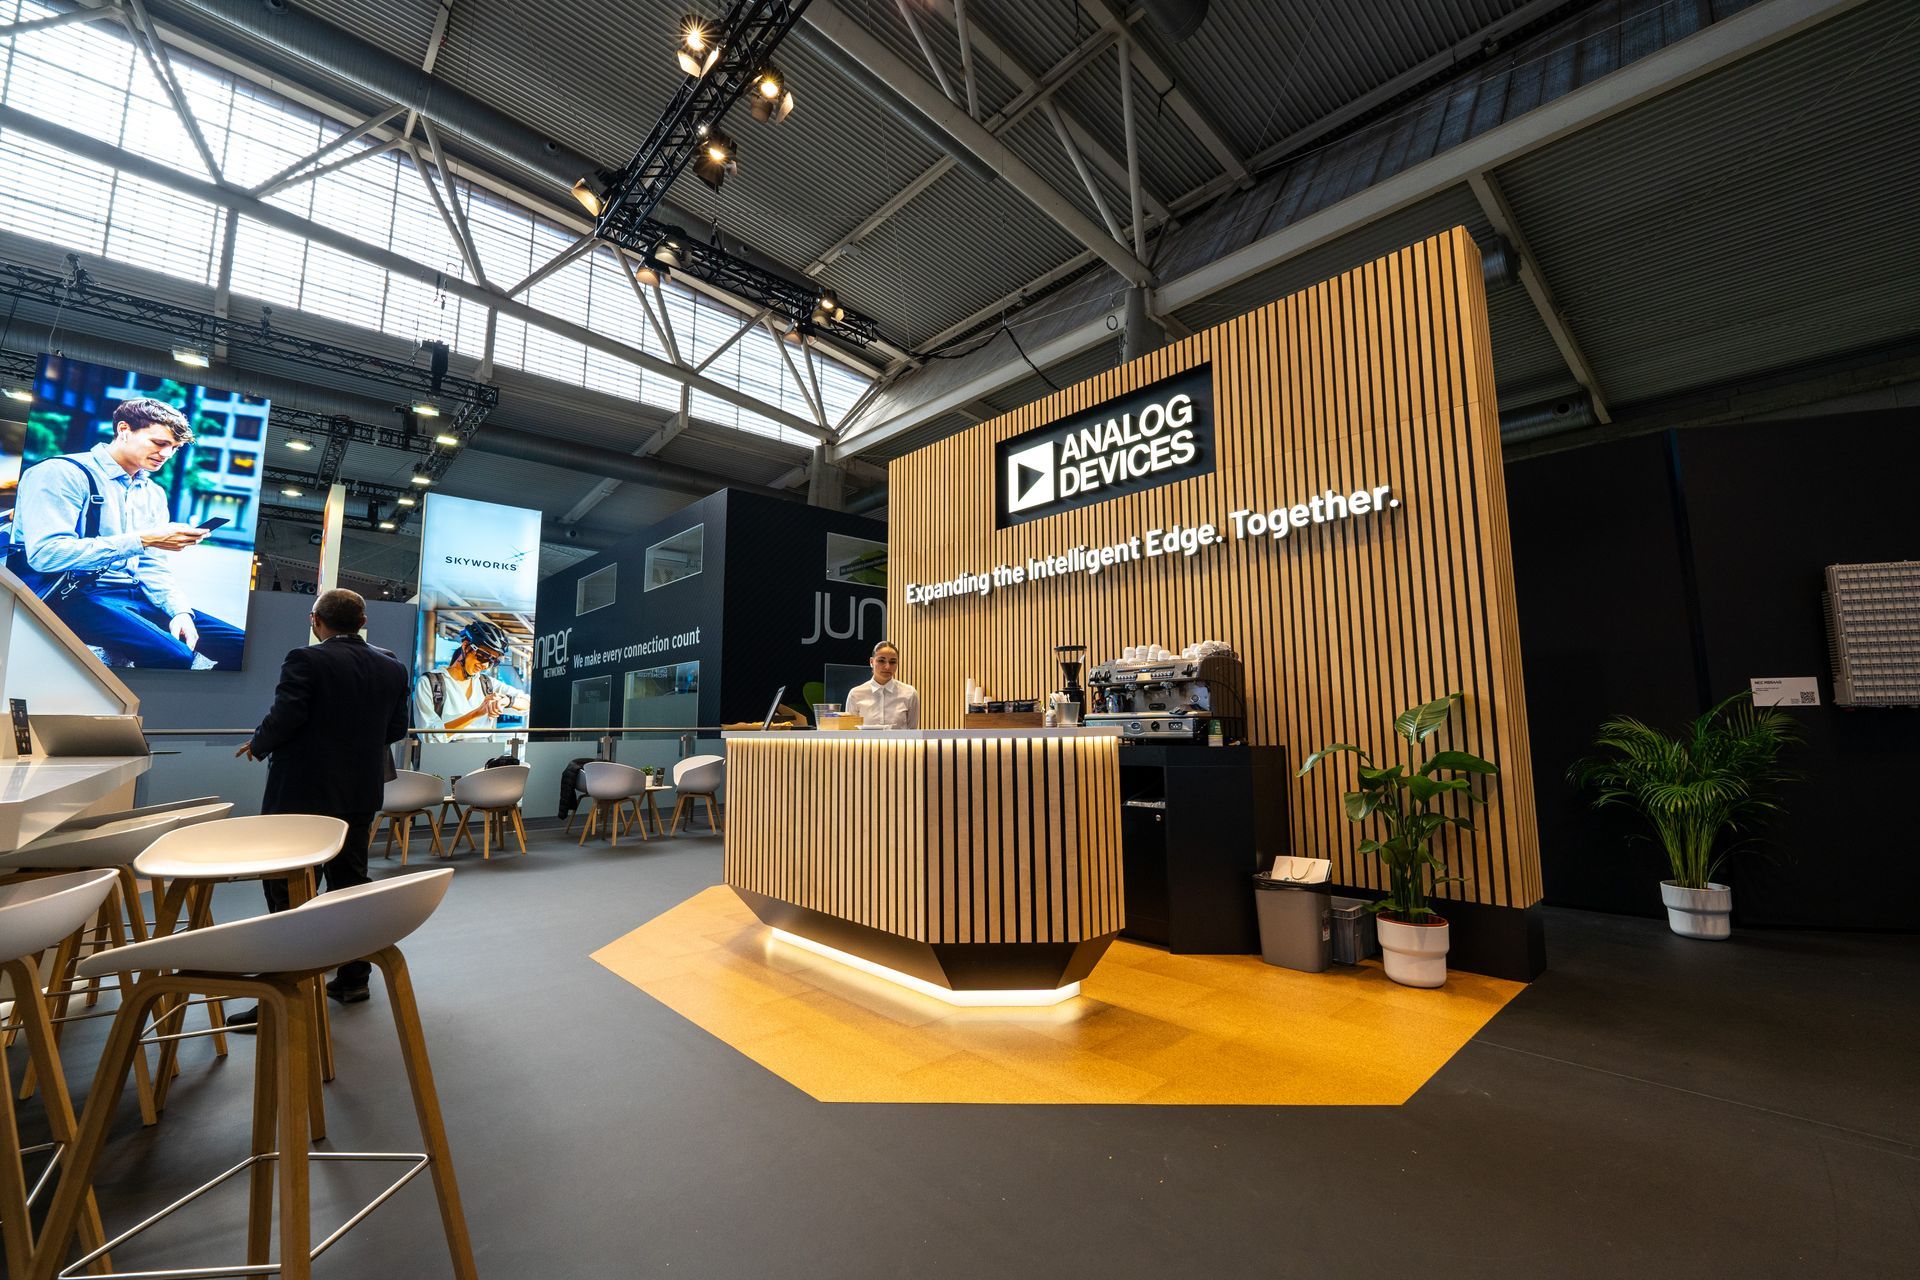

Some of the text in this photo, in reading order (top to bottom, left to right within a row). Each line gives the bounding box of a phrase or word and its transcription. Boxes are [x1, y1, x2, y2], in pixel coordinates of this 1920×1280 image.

[1060, 394, 1192, 465] ANALOG
[1060, 430, 1195, 498] DEVICES
[445, 556, 517, 571] SKYWORKS
[906, 485, 1399, 605] Expanding the Intelligent Edge. Together.
[573, 627, 700, 669] We make every connection count
